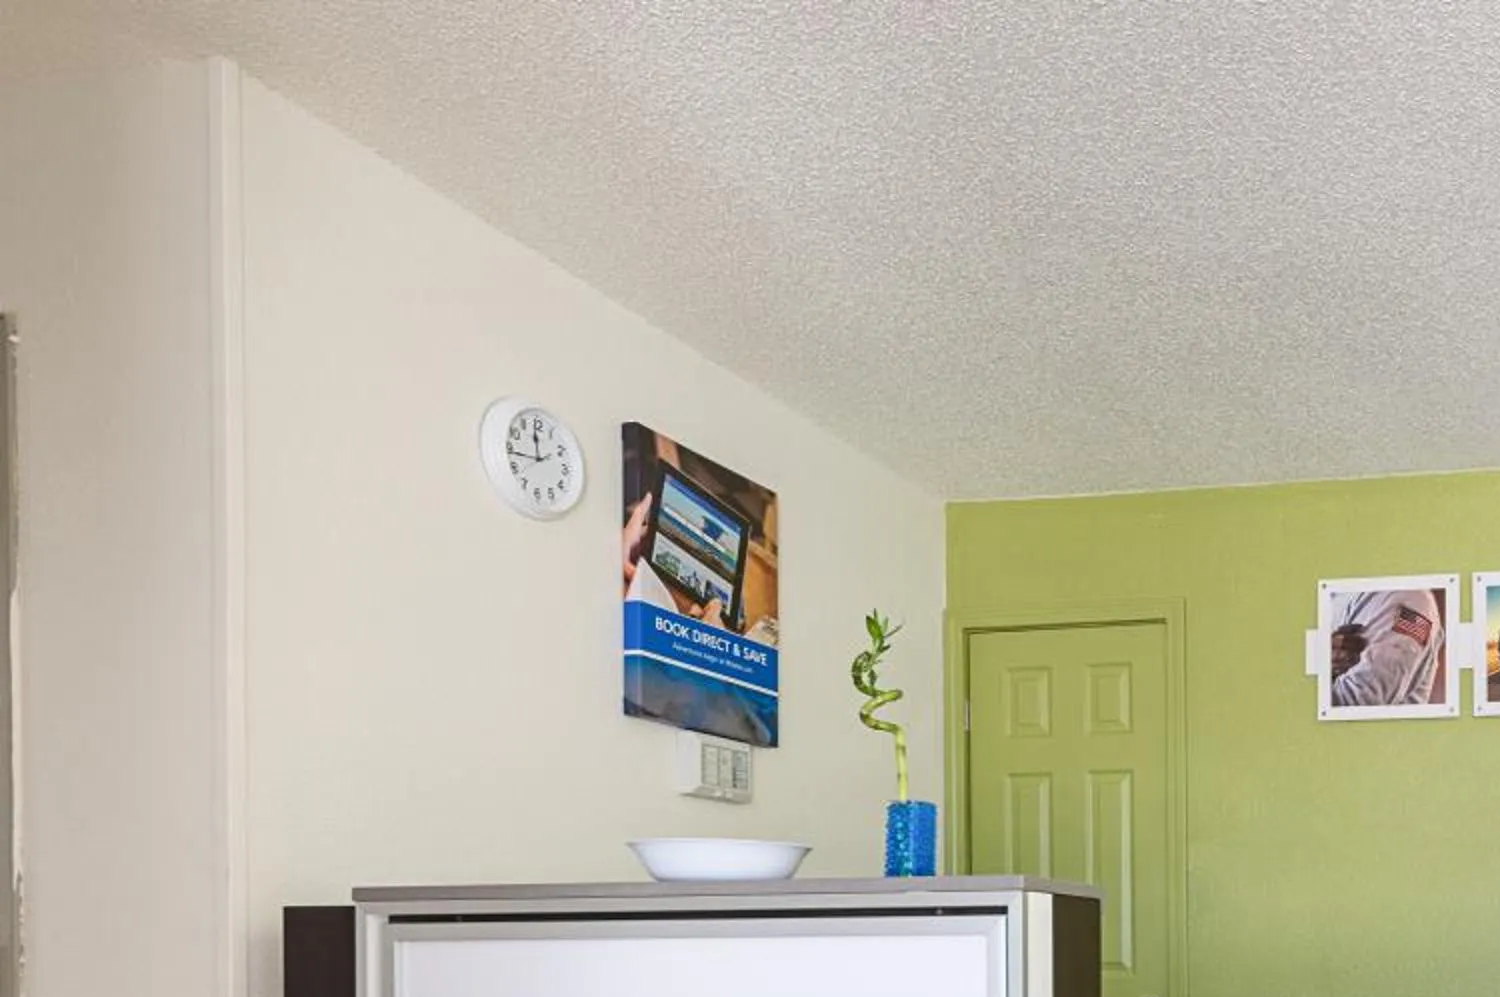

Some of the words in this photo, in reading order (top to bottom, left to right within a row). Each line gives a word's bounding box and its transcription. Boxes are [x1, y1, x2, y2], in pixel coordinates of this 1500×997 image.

[557, 444, 566, 458] 2
[561, 463, 570, 477] 3
[521, 477, 529, 490] 7
[533, 487, 541, 500] 6
[547, 487, 555, 500] 5
[655, 616, 690, 640] BOOK
[692, 628, 731, 653] DIRECT
[733, 643, 741, 657] &
[743, 647, 768, 667] SAVE
